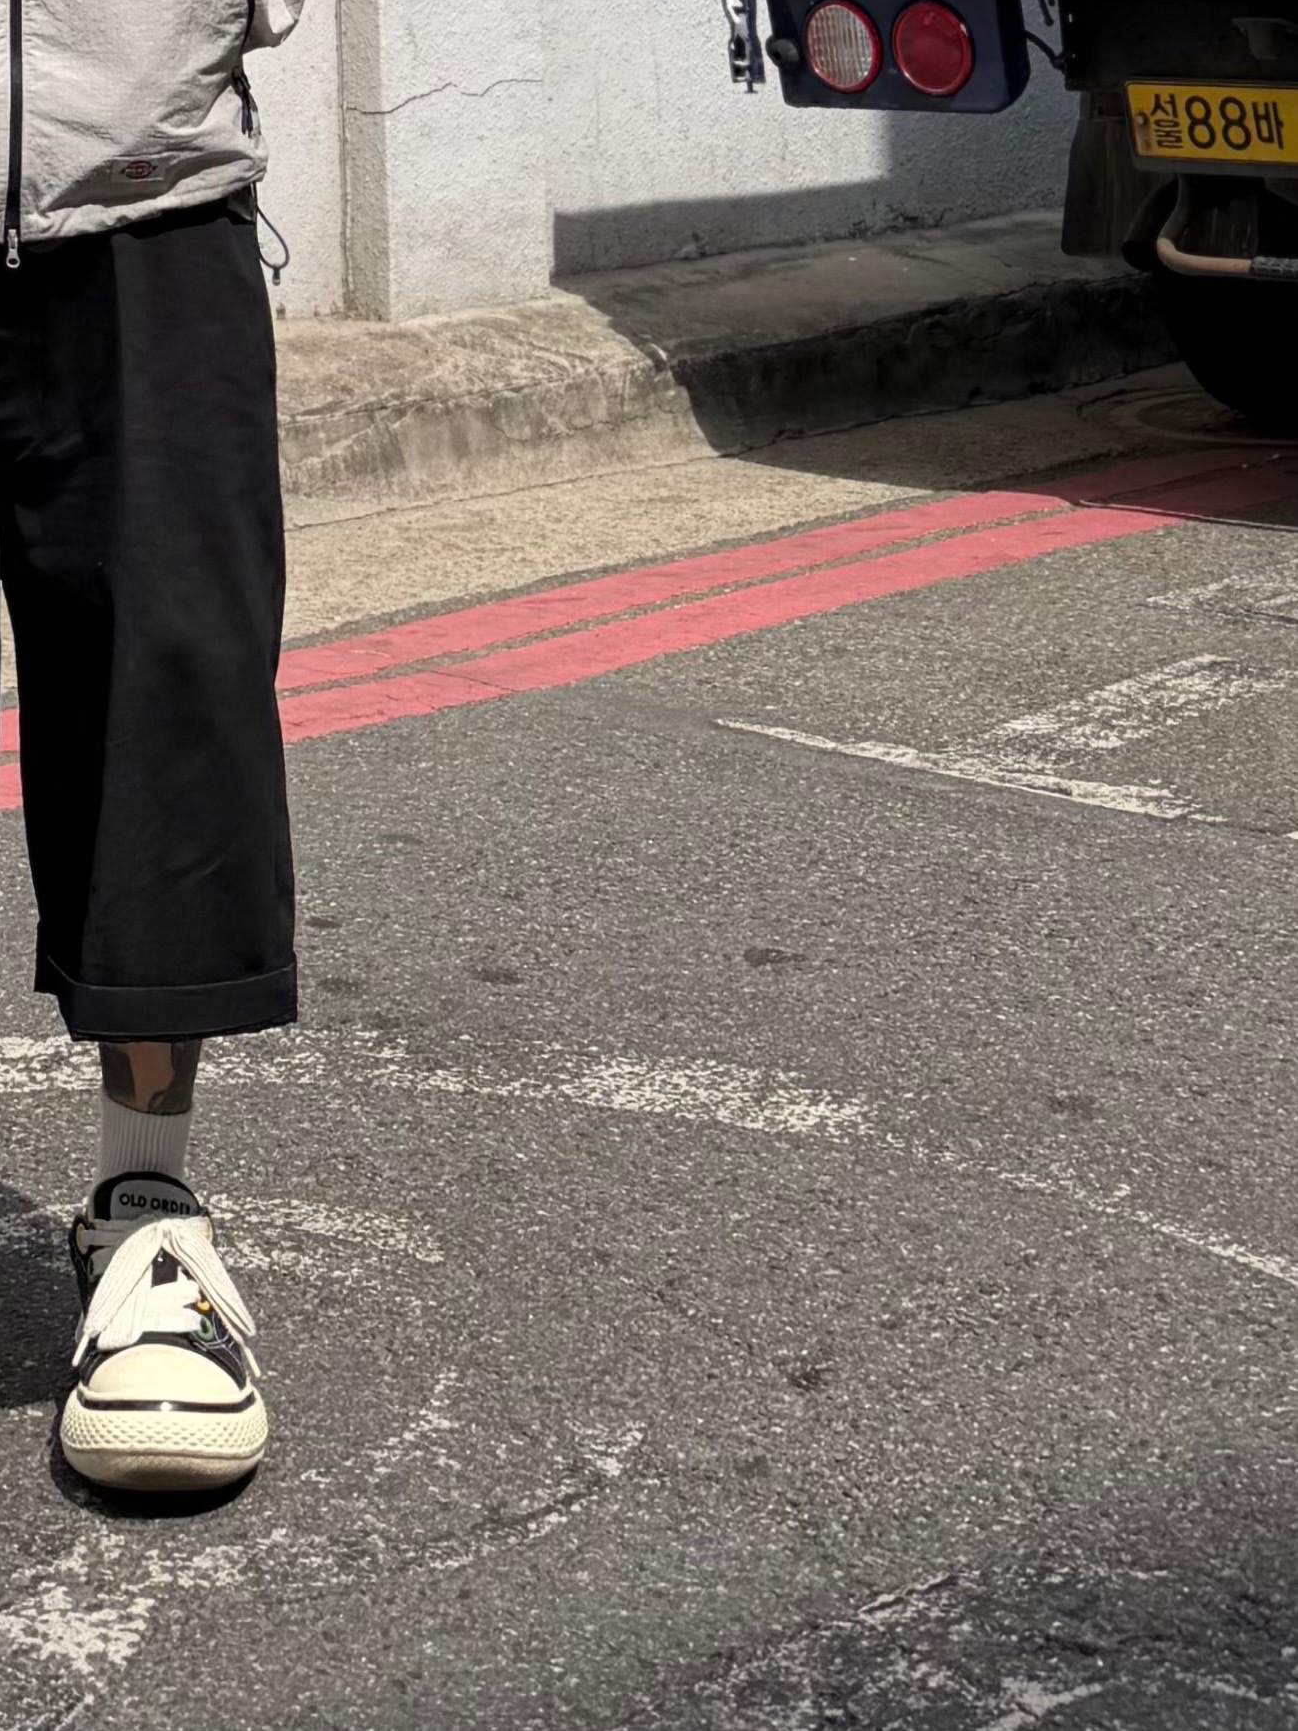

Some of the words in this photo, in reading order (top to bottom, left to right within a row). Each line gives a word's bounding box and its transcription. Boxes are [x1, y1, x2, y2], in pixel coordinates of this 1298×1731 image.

[1151, 93, 1183, 149] 서울
[1185, 95, 1284, 151] 88바
[119, 1193, 147, 1208] OLD
